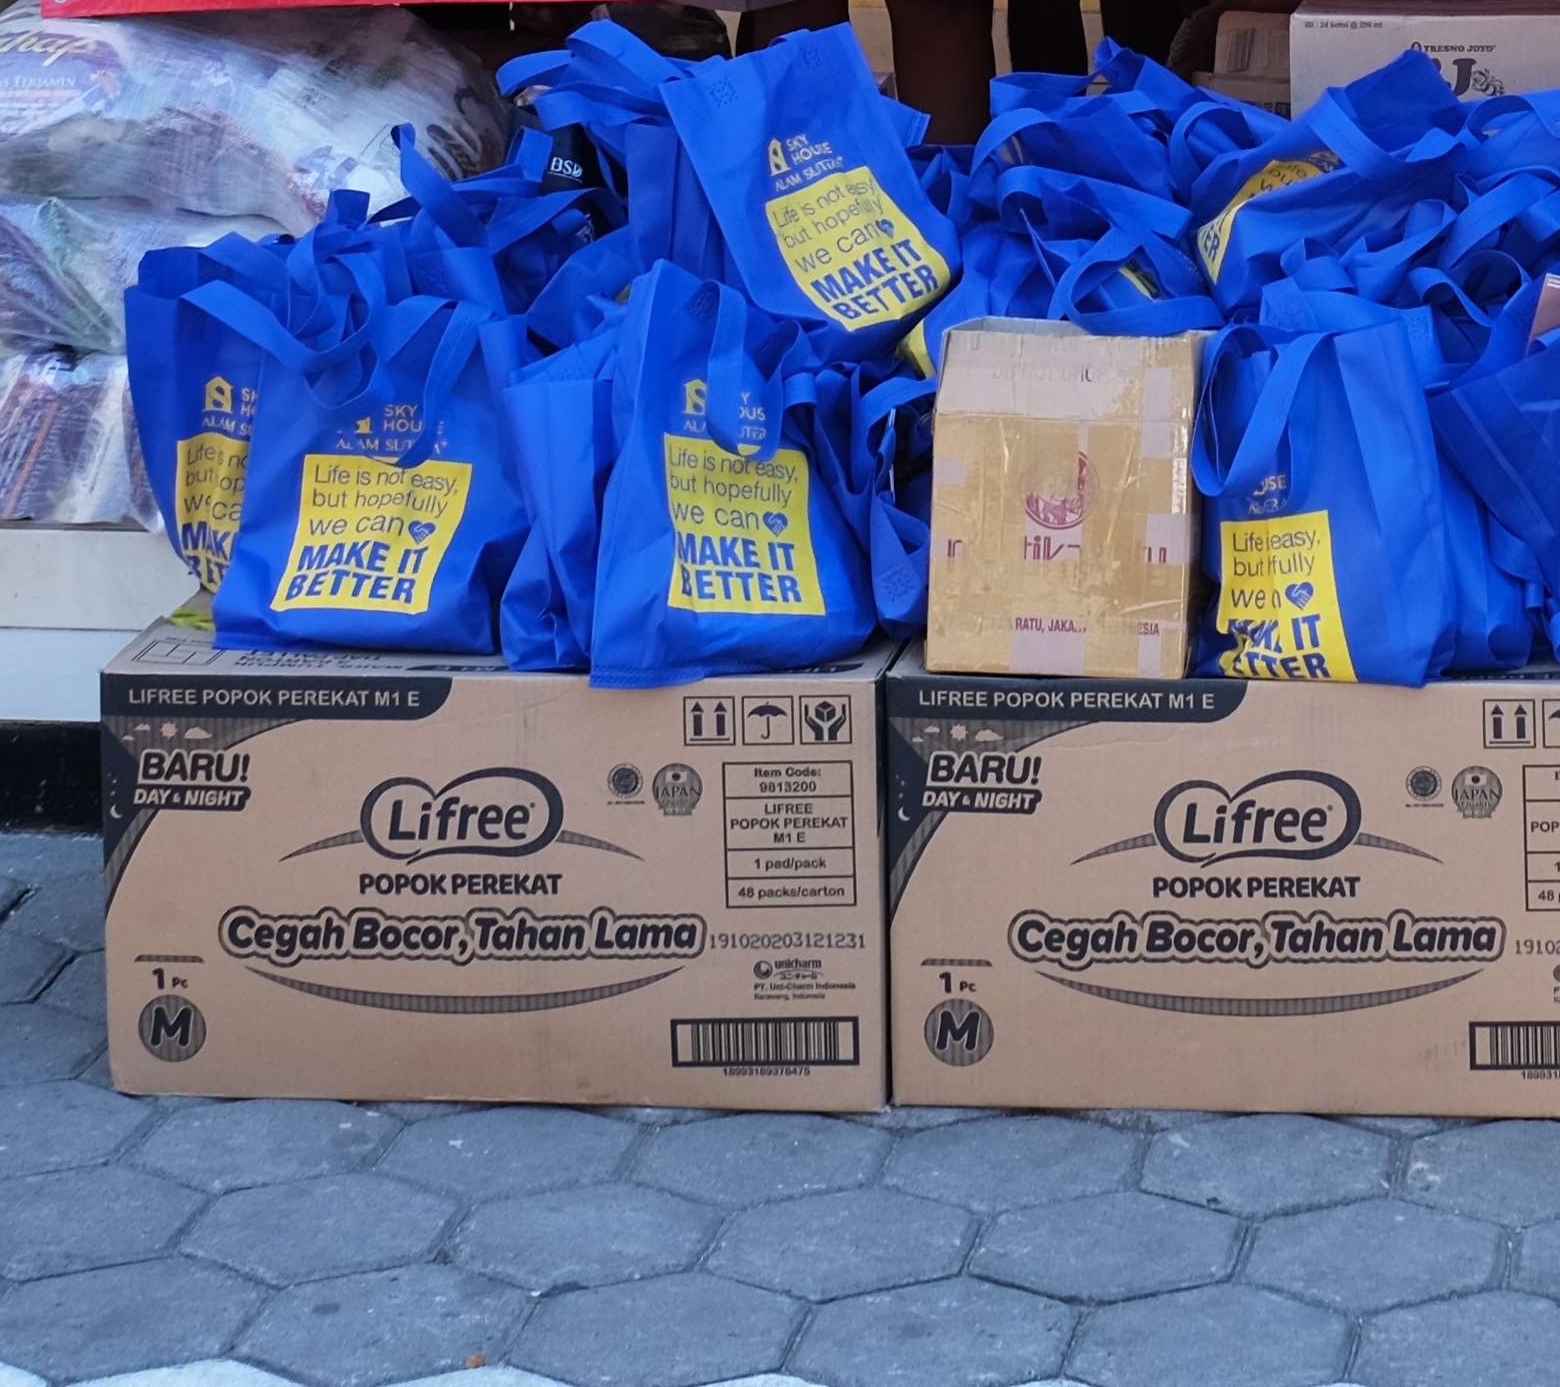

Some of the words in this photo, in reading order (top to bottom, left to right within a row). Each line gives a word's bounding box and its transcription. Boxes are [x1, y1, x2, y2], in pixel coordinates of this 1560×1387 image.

[811, 247, 896, 303] MAKE
[891, 239, 922, 267] IT
[832, 264, 939, 320] BETTER
[385, 405, 419, 417] SKY
[315, 464, 350, 485] Life
[357, 466, 371, 485] is
[377, 468, 406, 485] not
[411, 474, 458, 497] easy,
[313, 488, 348, 507] but
[354, 491, 448, 518] hopefully
[310, 518, 347, 536] we
[356, 515, 404, 536] can
[298, 540, 390, 572] MAKE
[398, 546, 429, 574] IT
[677, 531, 761, 569] MAKE
[768, 541, 794, 571] IT
[285, 569, 417, 604] BETTER
[682, 570, 801, 603] BETTER
[129, 689, 197, 705] LIFREE
[203, 690, 272, 705] POPOK
[279, 690, 368, 706] PEREKAT
[375, 691, 400, 706] M1
[408, 692, 420, 707] E
[919, 690, 987, 706] LIFREE
[994, 692, 1064, 708] POPOK
[1071, 693, 1162, 709] PEREKAT
[1169, 694, 1194, 709] M1
[1203, 694, 1214, 709] E
[142, 752, 250, 782] BARU!
[930, 754, 1042, 784] BARU!
[134, 789, 170, 805] DAY
[185, 790, 244, 807] NIGHT
[923, 792, 959, 806] DAY
[974, 792, 1034, 808] NIGHT
[1454, 787, 1500, 802] JAPAN
[389, 797, 530, 842] Lifree
[1183, 800, 1327, 843] Lifree
[360, 874, 451, 895] POPOK
[452, 874, 562, 894] PEREKAT
[1153, 877, 1241, 898] POPOK
[1247, 877, 1360, 898] PEREKAT
[1538, 890, 1554, 901] 48
[228, 916, 343, 957] Cegah
[353, 918, 471, 955] Bocor,
[475, 918, 585, 951] Tahan
[595, 916, 698, 951] Lama
[1018, 920, 1137, 960] Cegah
[1146, 920, 1266, 958] Bocor,
[1271, 920, 1383, 953] Tahan
[1393, 919, 1496, 952] Lama
[152, 969, 165, 989] 1
[940, 972, 952, 992] 1
[151, 1007, 191, 1047] M
[936, 1011, 980, 1052] M
